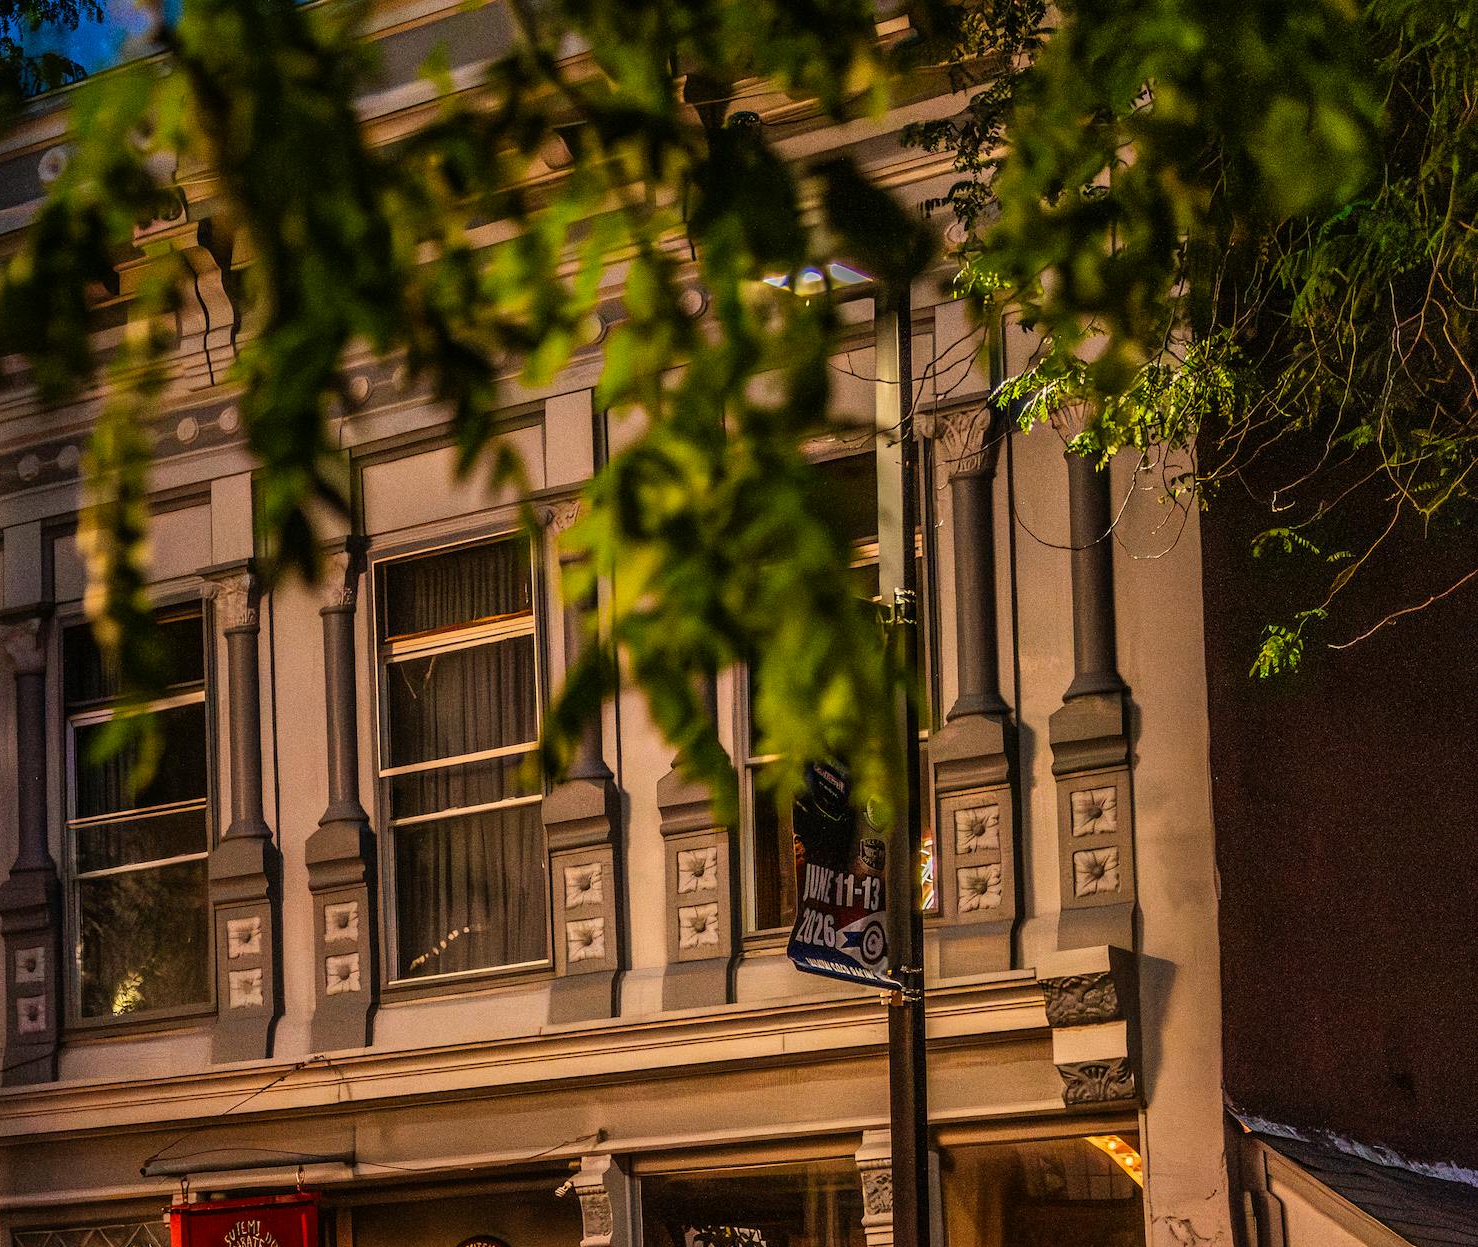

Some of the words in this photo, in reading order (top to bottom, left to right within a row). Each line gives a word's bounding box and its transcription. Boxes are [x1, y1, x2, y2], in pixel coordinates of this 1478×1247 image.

[802, 863, 834, 904] JUNE
[835, 872, 881, 912] 11-13
[795, 907, 837, 948] 2026
